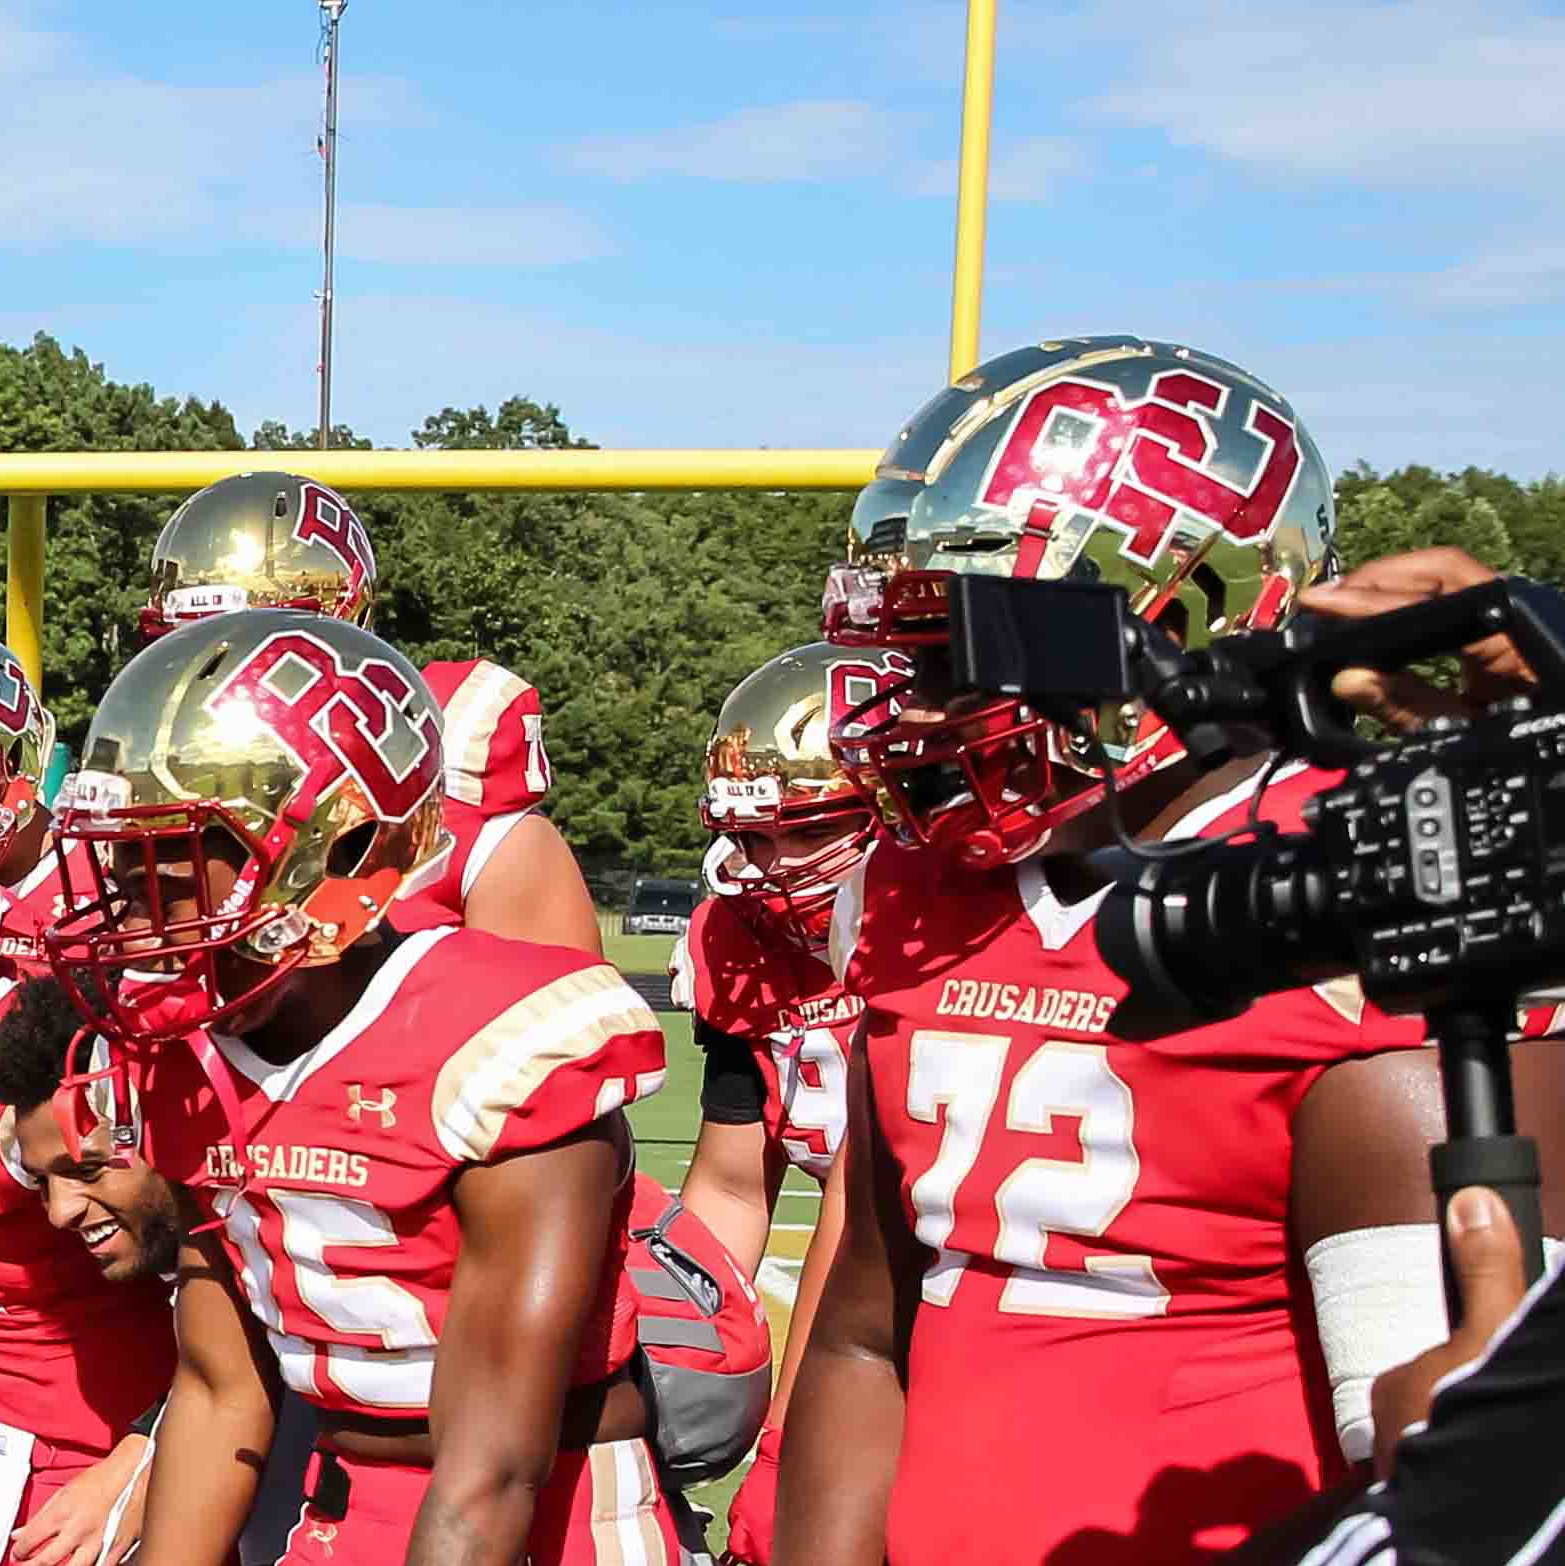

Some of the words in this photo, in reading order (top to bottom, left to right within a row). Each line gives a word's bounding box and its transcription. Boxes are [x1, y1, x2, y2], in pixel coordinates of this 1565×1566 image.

[936, 979, 1117, 1033] CRUSADERS
[205, 1144, 371, 1188] CRSADERS
[907, 1030, 1172, 1320] 72
